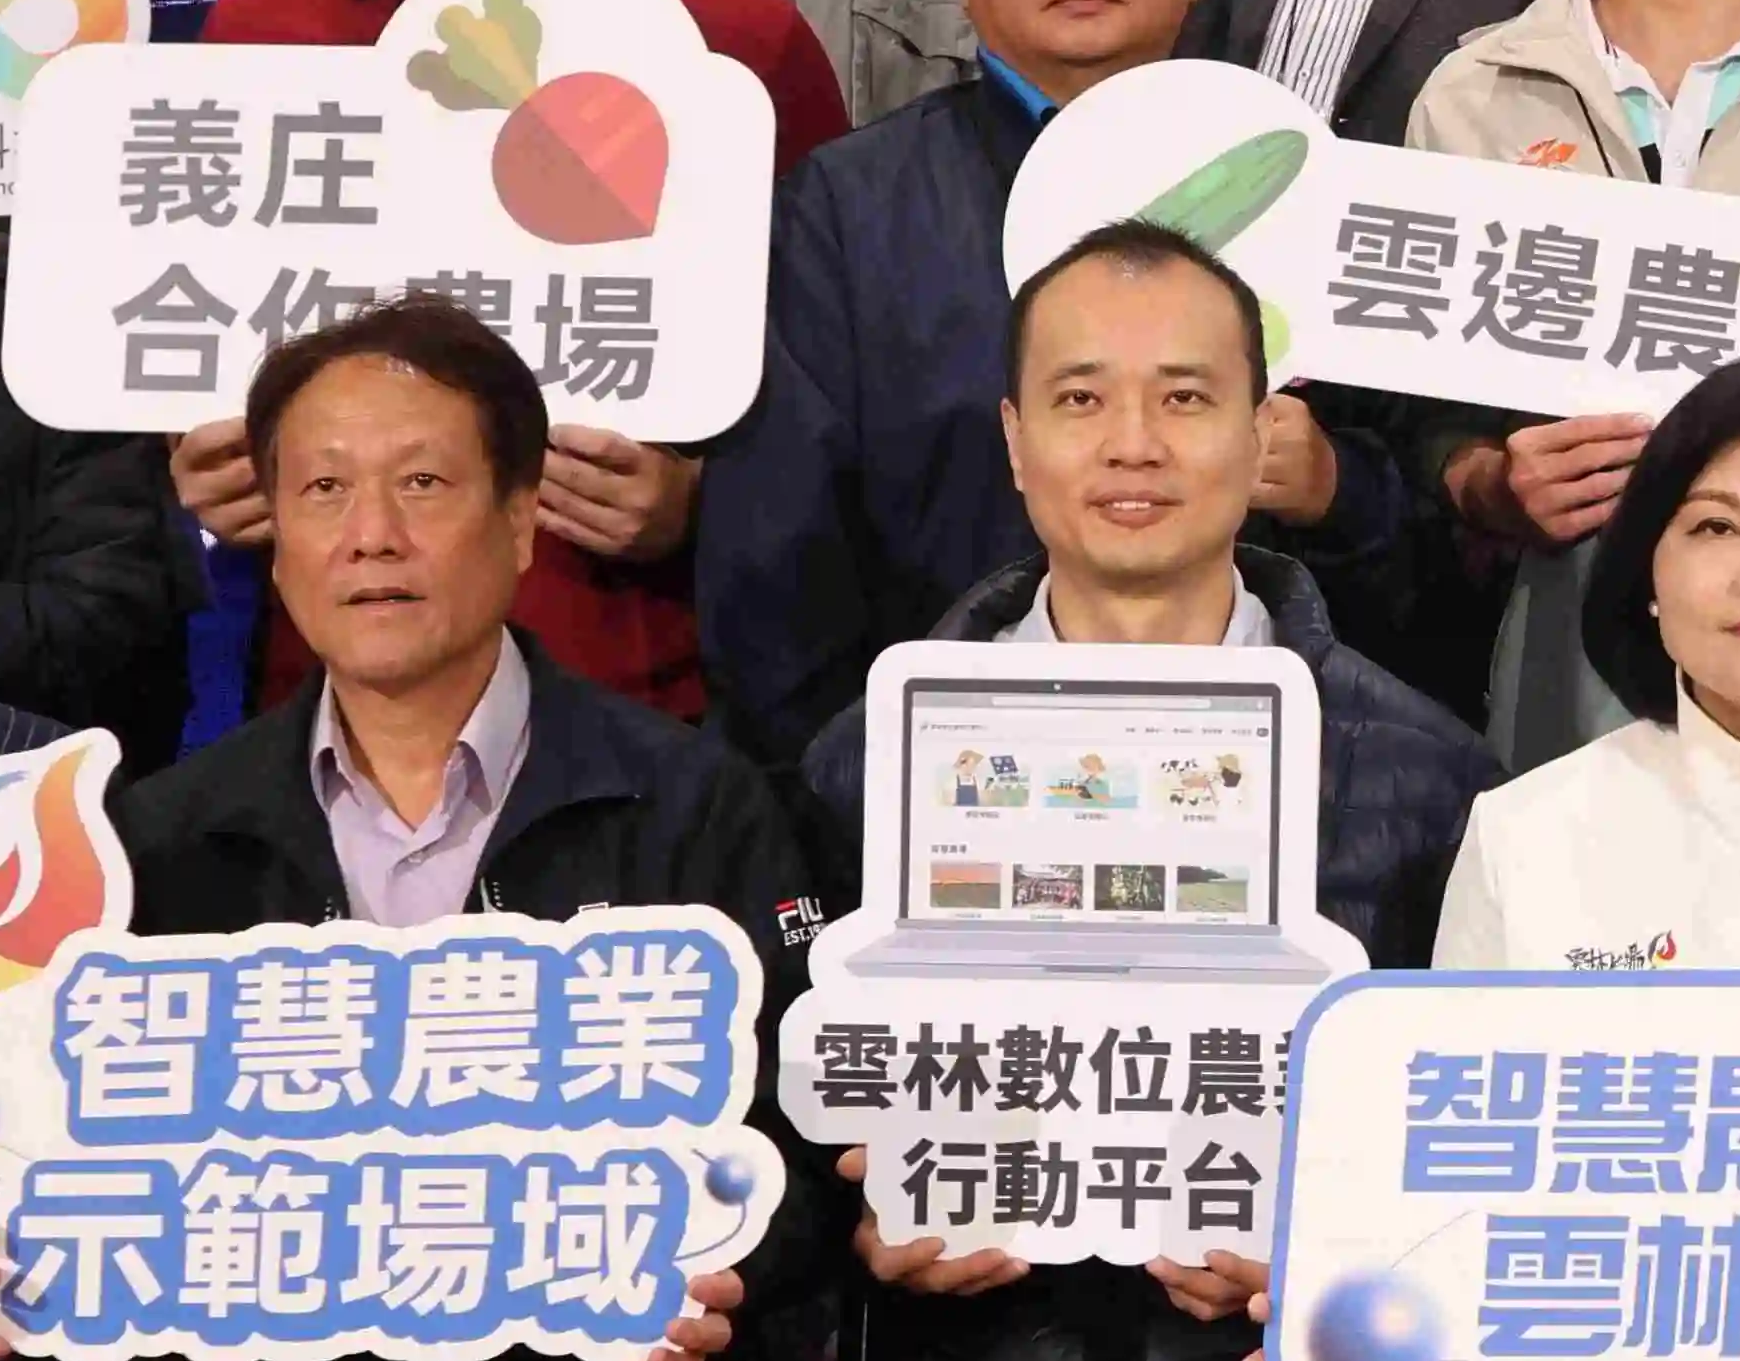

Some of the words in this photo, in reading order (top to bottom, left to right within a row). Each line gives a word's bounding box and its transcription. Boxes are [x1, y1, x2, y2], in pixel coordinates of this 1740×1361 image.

[118, 97, 384, 227] 義庄
[60, 944, 712, 1118] 智慧農業
[812, 1024, 1294, 1116] 雲林數位農
[11, 1161, 663, 1320] 示範場域
[901, 1138, 1263, 1232] 行動平台
